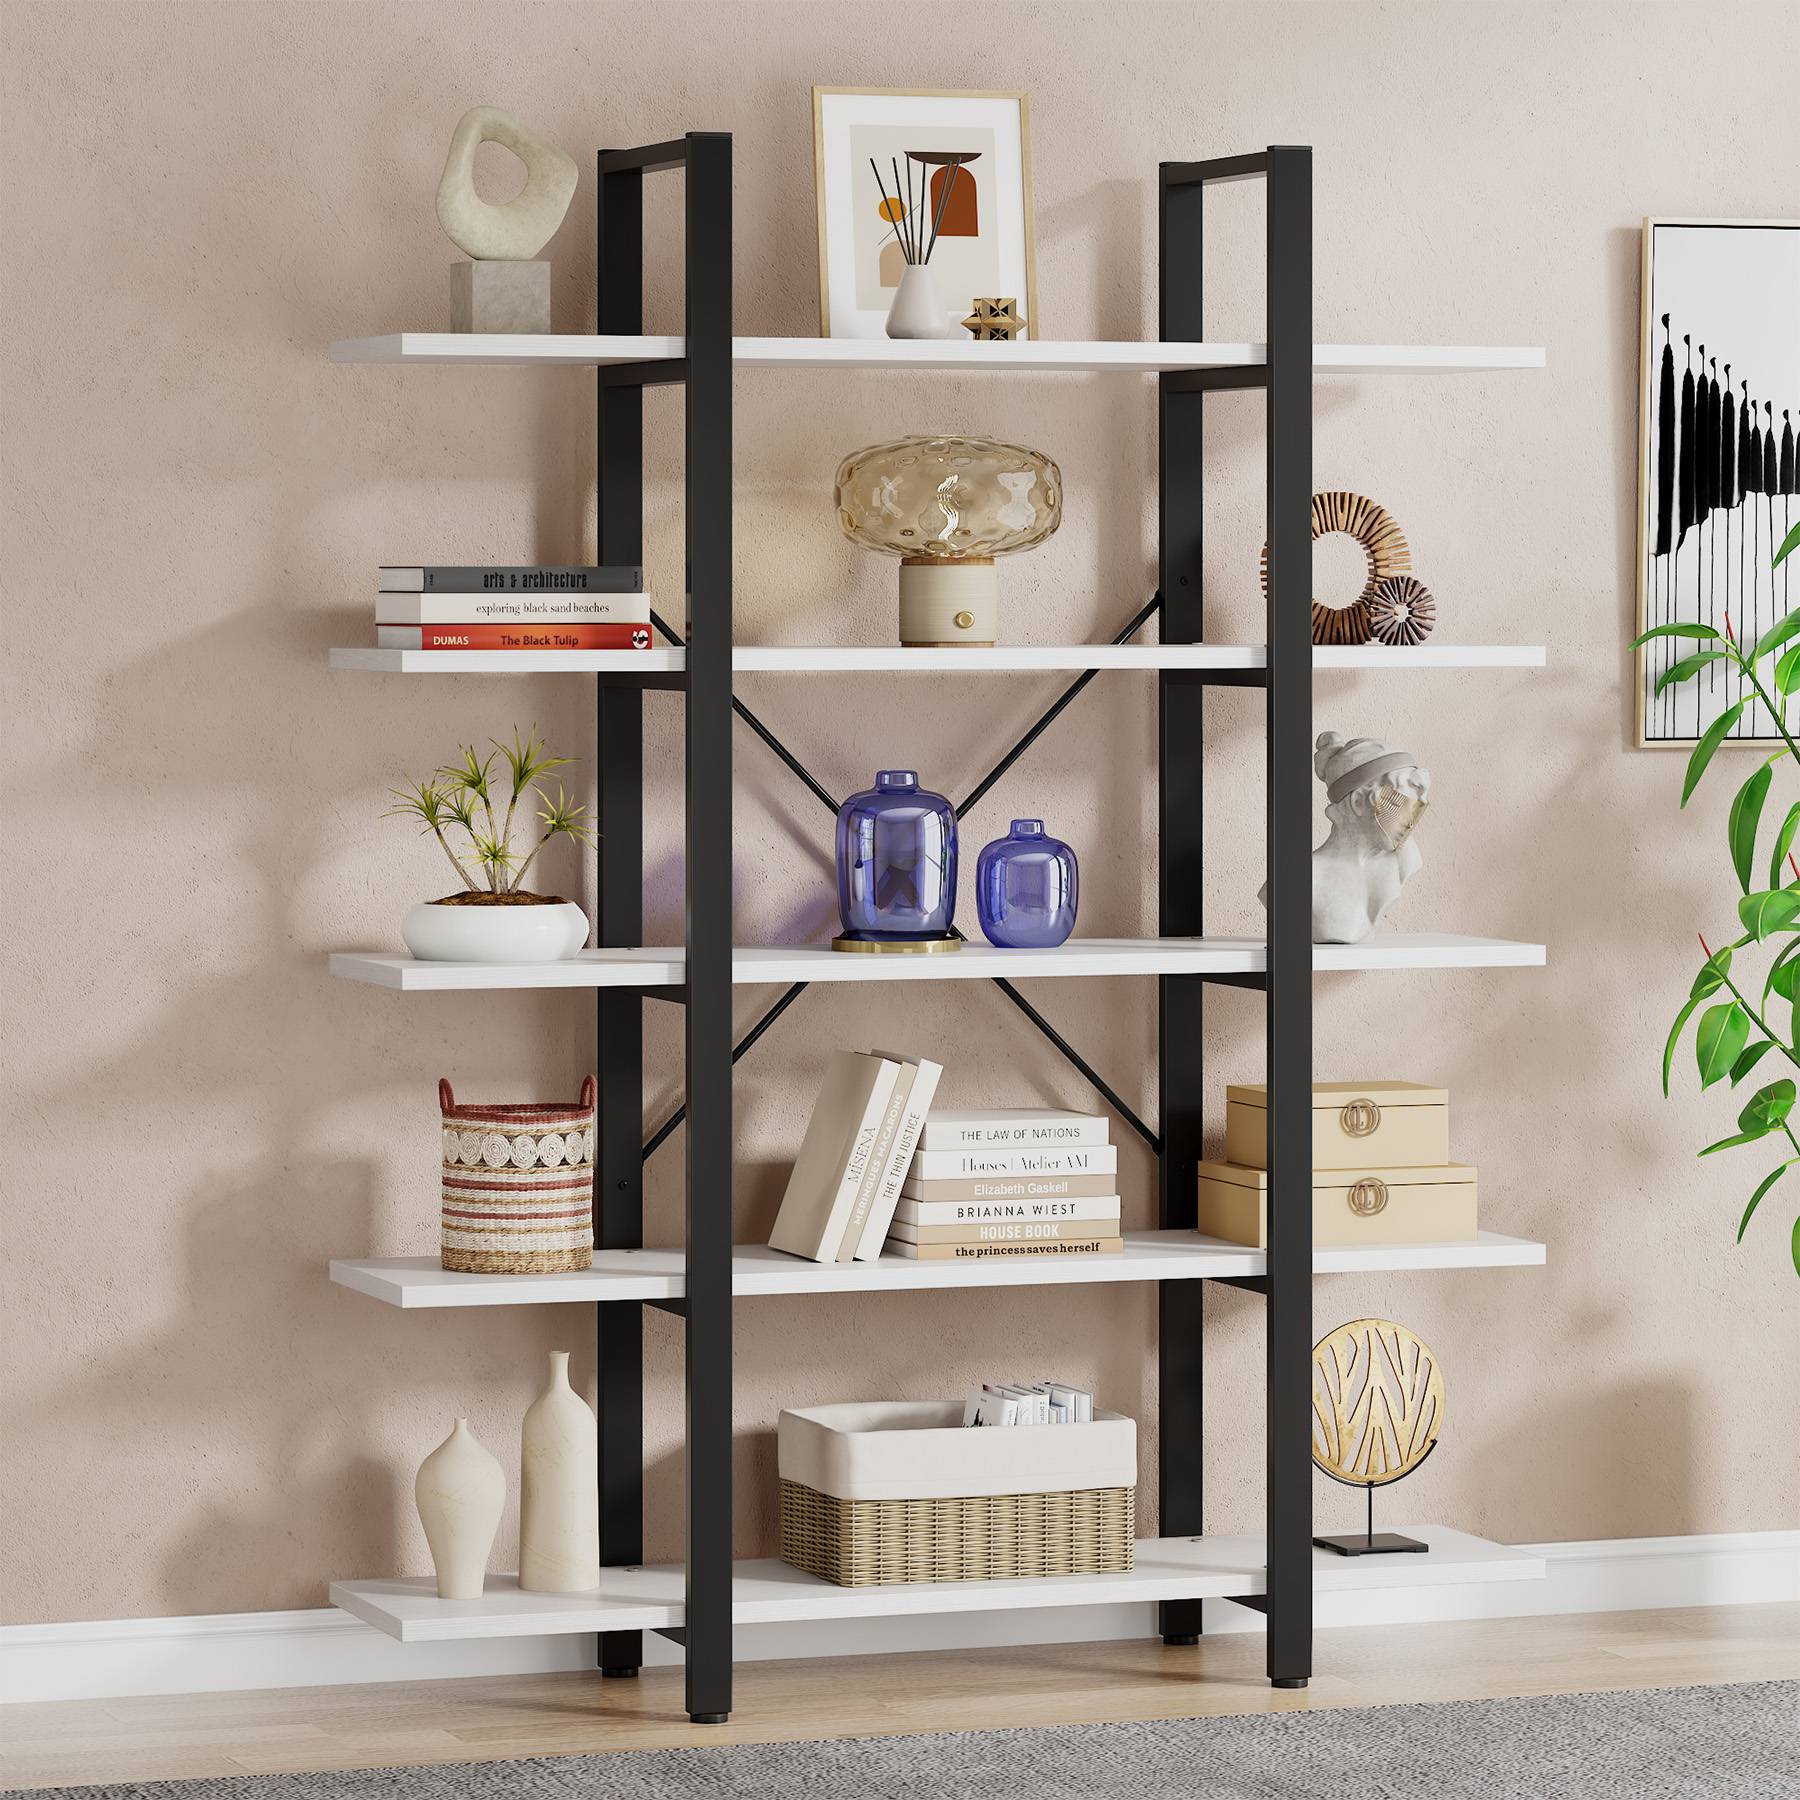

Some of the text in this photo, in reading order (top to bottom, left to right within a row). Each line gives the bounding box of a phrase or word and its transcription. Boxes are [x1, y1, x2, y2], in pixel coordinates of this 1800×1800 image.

[484, 571, 587, 588] arts & architecture
[476, 601, 610, 616] exploring black sand beaches
[433, 636, 469, 645] DUMAS
[501, 635, 579, 648] The Black Tulip
[960, 1127, 1081, 1141] THE LAW OF NATIONS
[853, 1094, 904, 1225] MERINGUES MACARONS
[882, 1111, 921, 1200] THE THIN JUSTICE
[962, 1157, 1007, 1172] Houses
[1021, 1155, 1061, 1170] Atelier
[974, 1181, 1068, 1196] Elizabeth Gaskell
[957, 1203, 1076, 1218] BRIANNA WIEST
[980, 1223, 1060, 1240] HOUSE BOOK
[955, 1242, 1101, 1258] the princess saves herself
